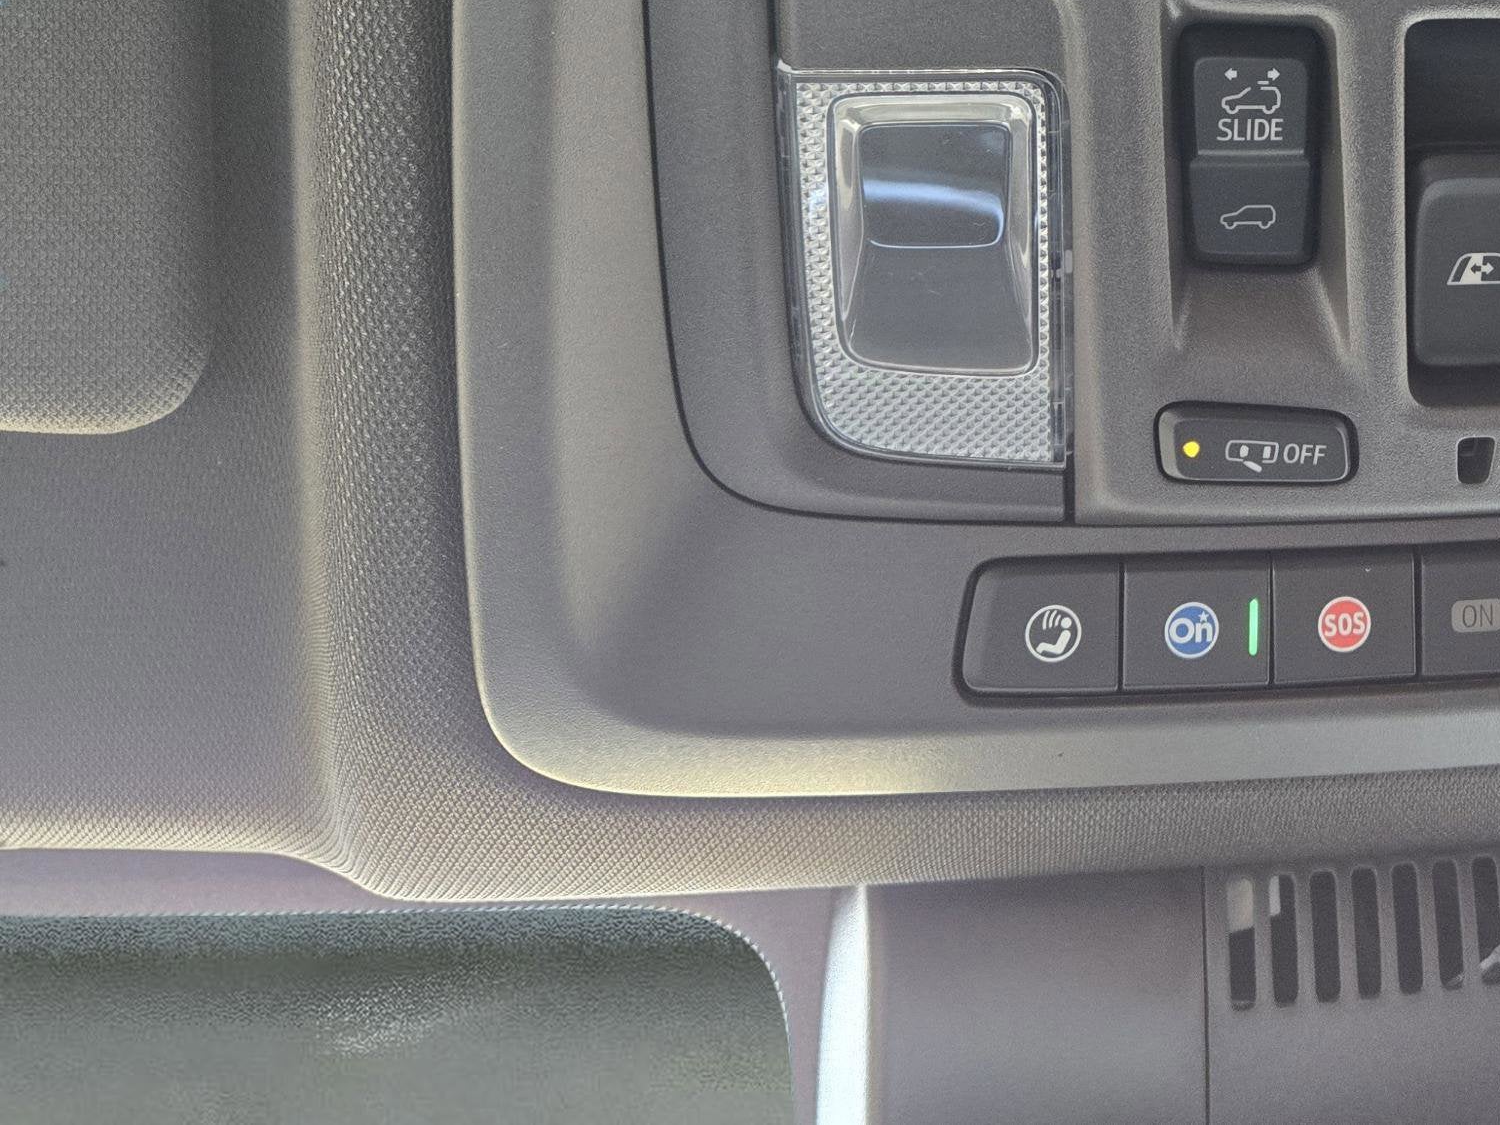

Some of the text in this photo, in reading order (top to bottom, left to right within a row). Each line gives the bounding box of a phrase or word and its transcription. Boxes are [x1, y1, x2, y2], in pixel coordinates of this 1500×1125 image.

[1216, 118, 1284, 141] SLIDE
[1283, 443, 1327, 465] OFF
[1324, 612, 1366, 638] SOS
[1462, 603, 1495, 628] ON
[1168, 619, 1213, 644] On
